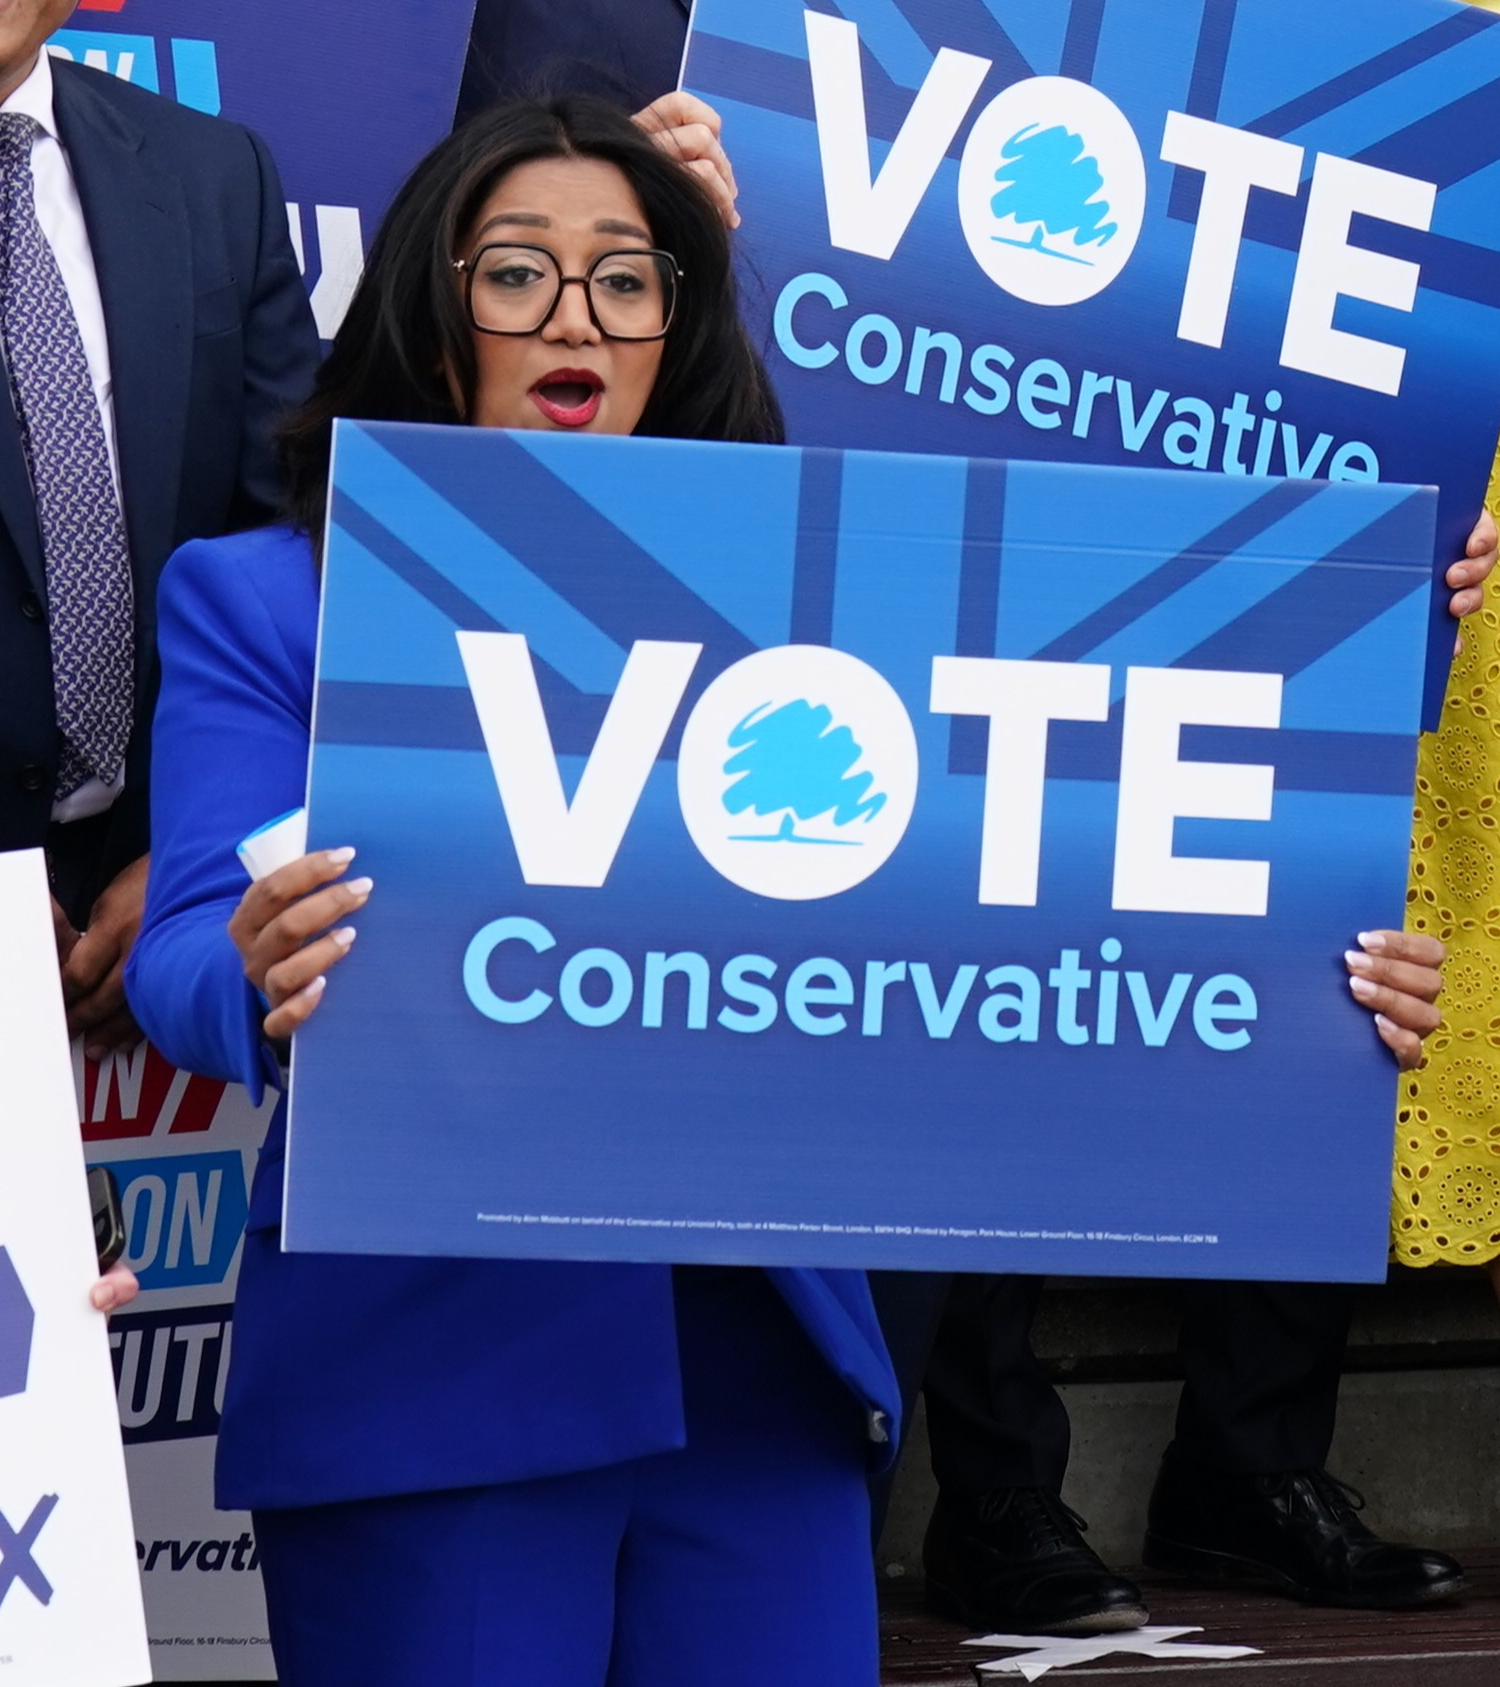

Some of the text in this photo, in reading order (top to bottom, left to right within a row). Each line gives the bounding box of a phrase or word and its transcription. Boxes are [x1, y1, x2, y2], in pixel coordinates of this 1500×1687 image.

[803, 8, 1437, 398] VOTE
[772, 272, 1380, 482] Conservative
[455, 630, 1283, 915] VOTE
[463, 915, 1259, 1051] Conservative
